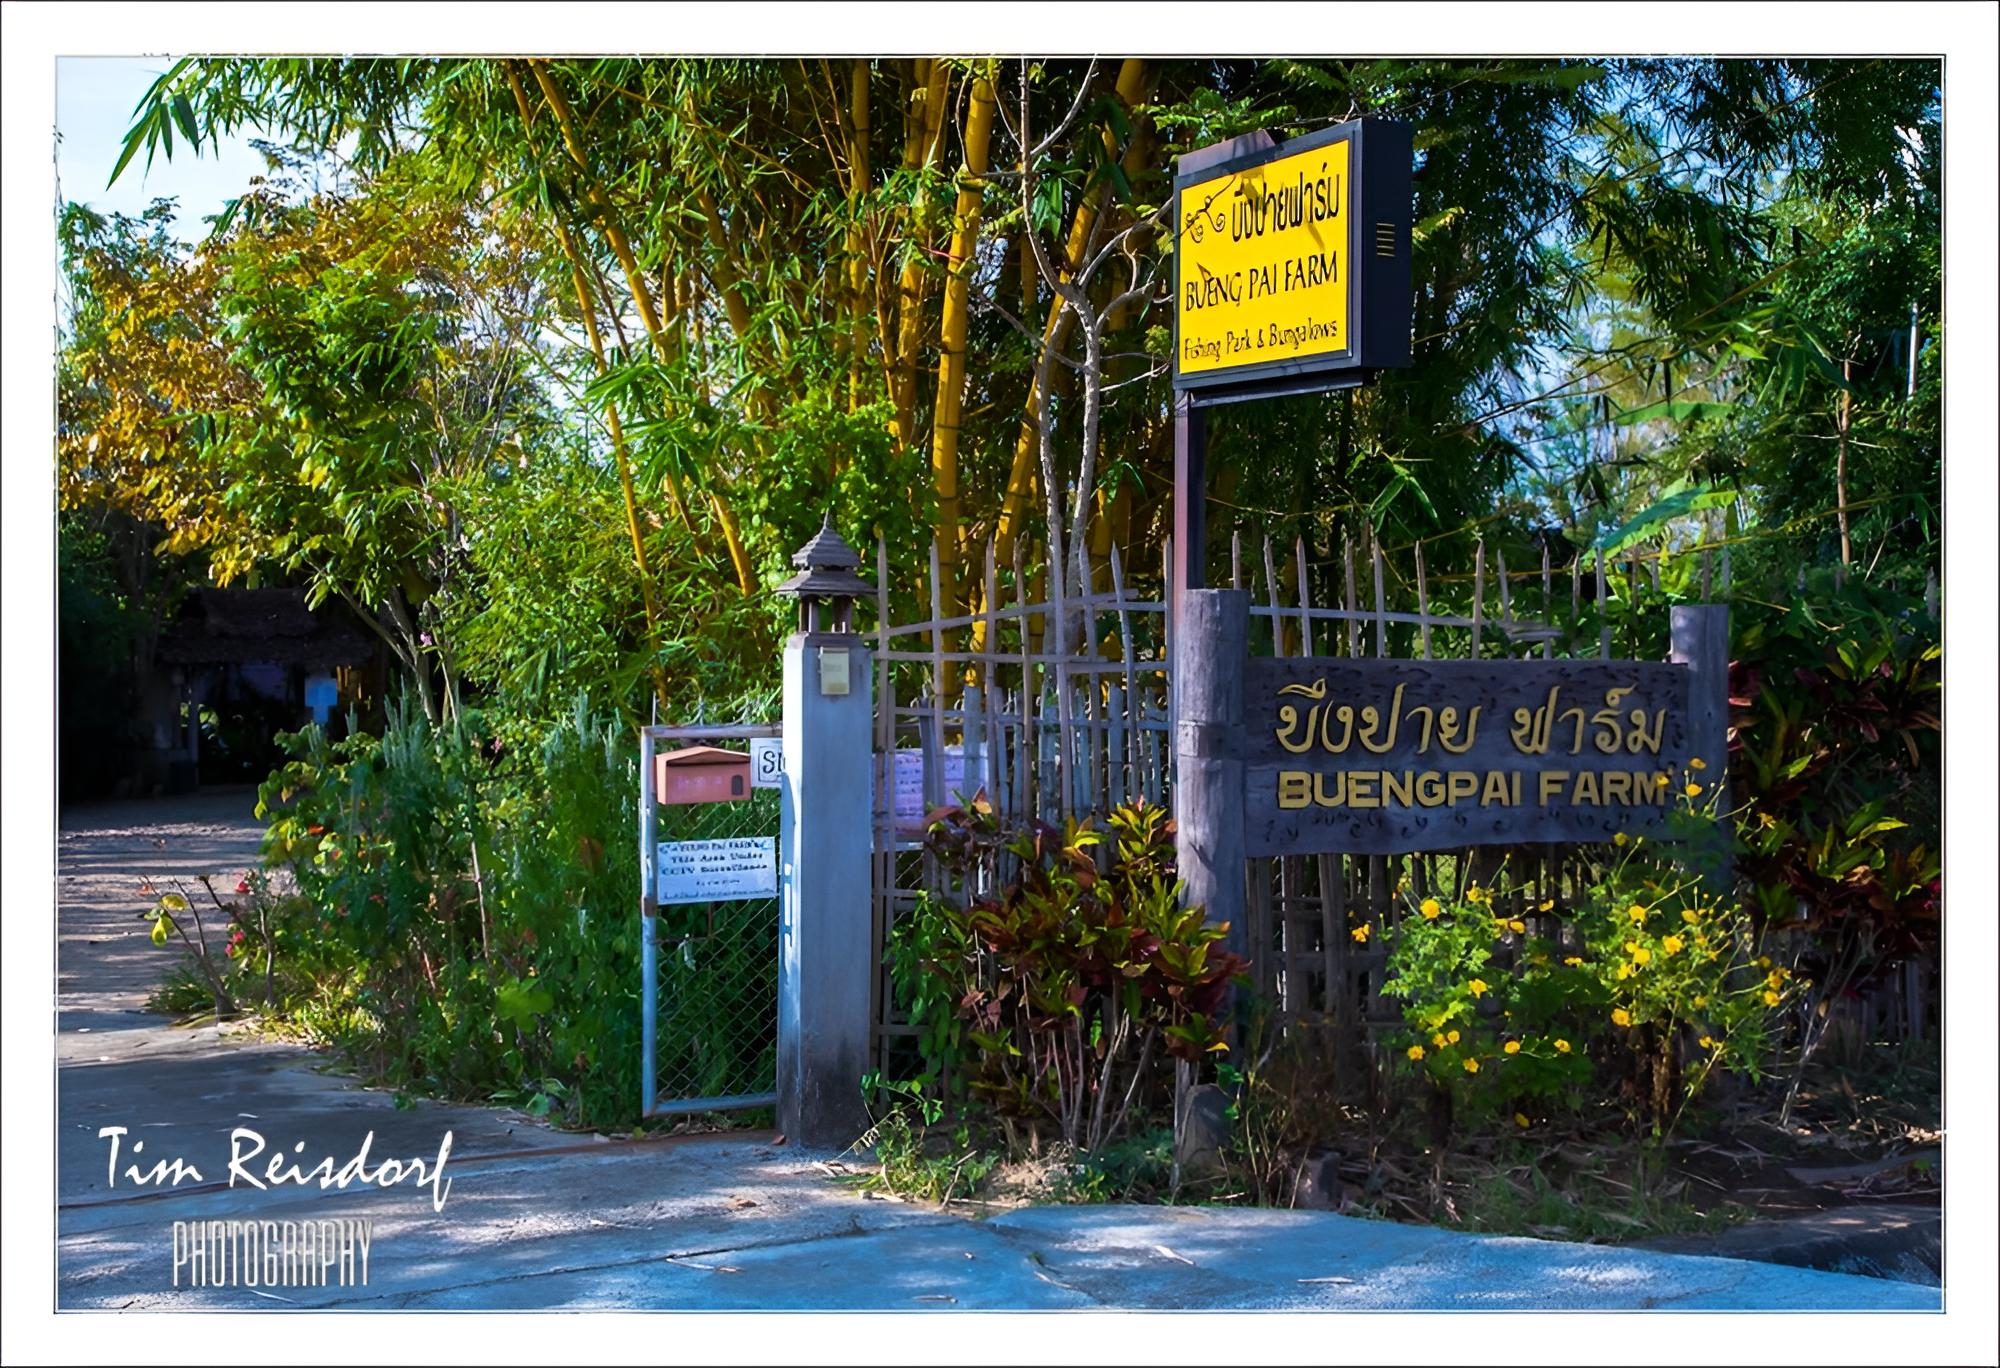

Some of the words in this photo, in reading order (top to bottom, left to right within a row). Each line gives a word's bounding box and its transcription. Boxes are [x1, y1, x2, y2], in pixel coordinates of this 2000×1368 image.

[1186, 272, 1242, 311] BUENG
[1249, 263, 1276, 299] PAI
[1285, 251, 1337, 291] FARM
[1185, 337, 1220, 362] Fishing
[1227, 329, 1251, 354] Park
[1257, 329, 1264, 348] &
[1269, 317, 1337, 350] Bungalows
[1275, 678, 1482, 754] บึงปาย
[1510, 682, 1667, 754] ฟาร์ม
[1278, 771, 1521, 808] BUENGPAI
[1539, 770, 1666, 807] FARM
